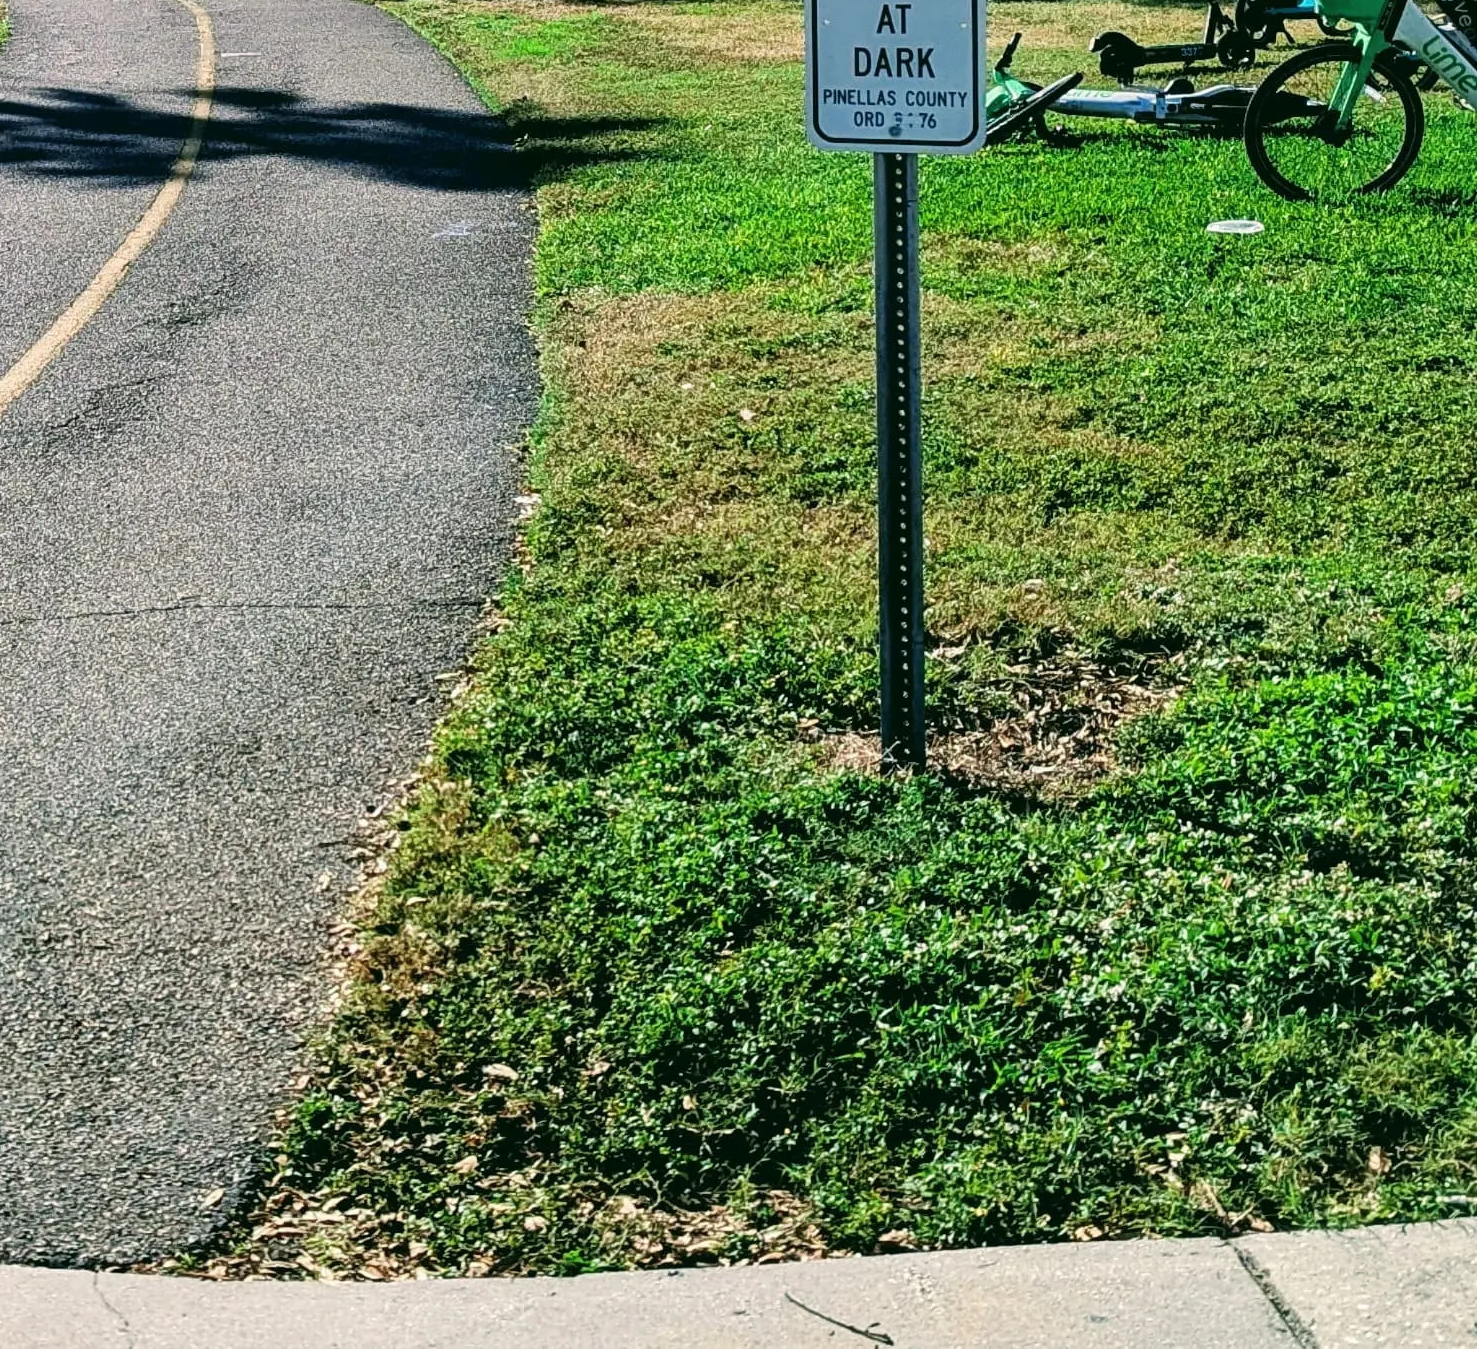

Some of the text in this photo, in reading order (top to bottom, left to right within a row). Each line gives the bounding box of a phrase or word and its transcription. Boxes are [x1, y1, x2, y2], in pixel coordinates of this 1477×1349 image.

[876, 4, 912, 35] AT
[854, 47, 935, 78] DARK
[823, 89, 968, 108] PINELLAS COUNTY
[853, 111, 885, 127] ORD
